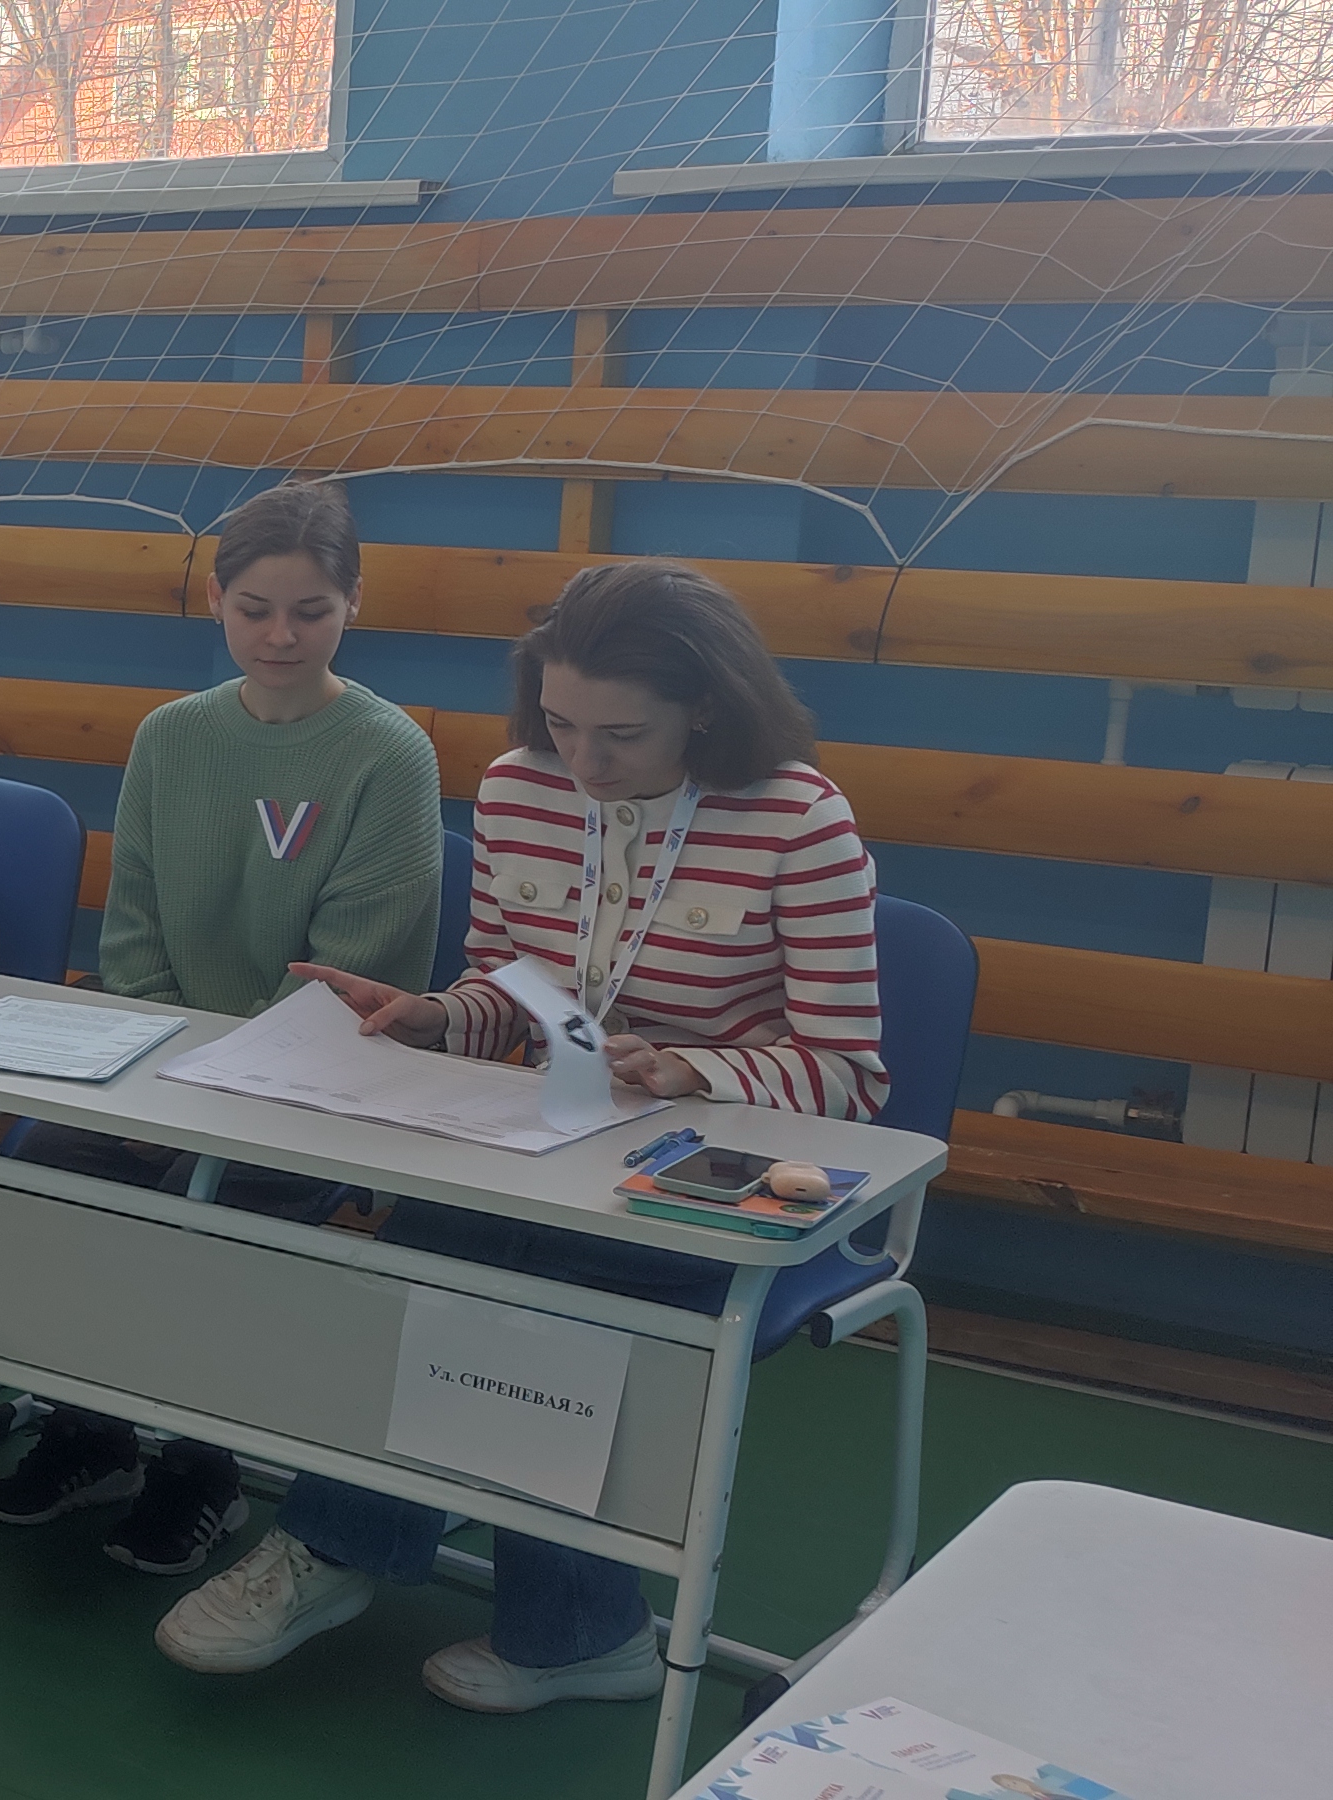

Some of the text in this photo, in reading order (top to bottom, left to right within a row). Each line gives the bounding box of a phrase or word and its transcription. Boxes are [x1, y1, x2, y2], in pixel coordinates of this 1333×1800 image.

[427, 1363, 595, 1418] Ул. СИРЕНЕВАЯ 26
